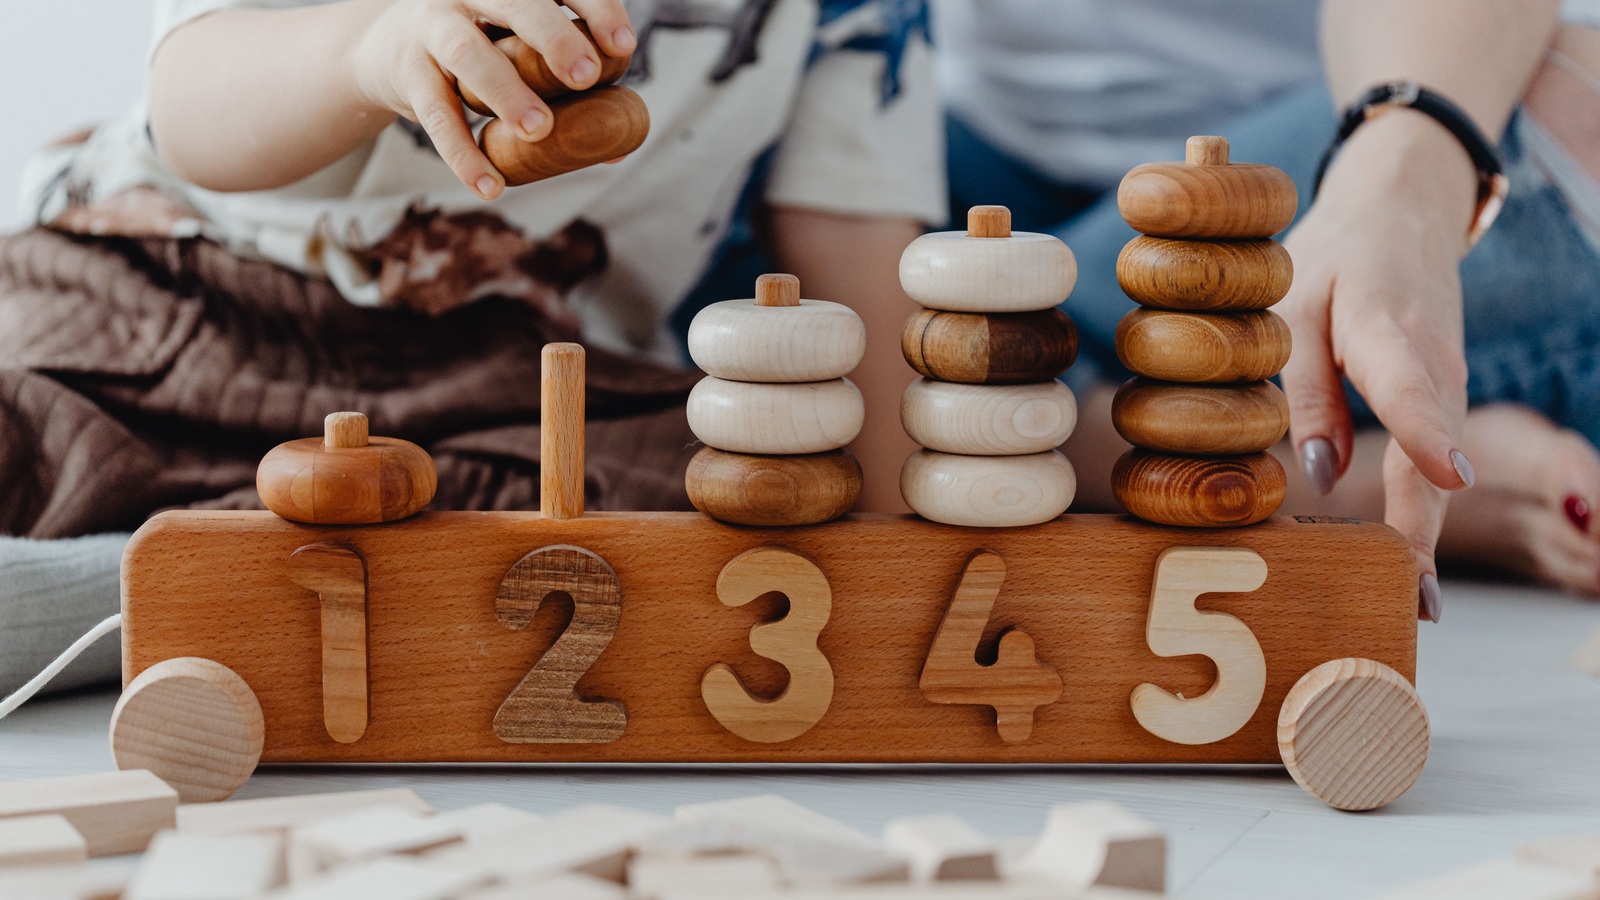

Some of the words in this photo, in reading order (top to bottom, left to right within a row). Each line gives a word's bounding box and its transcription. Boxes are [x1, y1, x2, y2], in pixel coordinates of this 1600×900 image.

[288, 543, 367, 744] 1
[493, 544, 627, 744] 2
[701, 546, 834, 744] 3
[919, 549, 1063, 743] 4
[1130, 546, 1268, 745] 5
